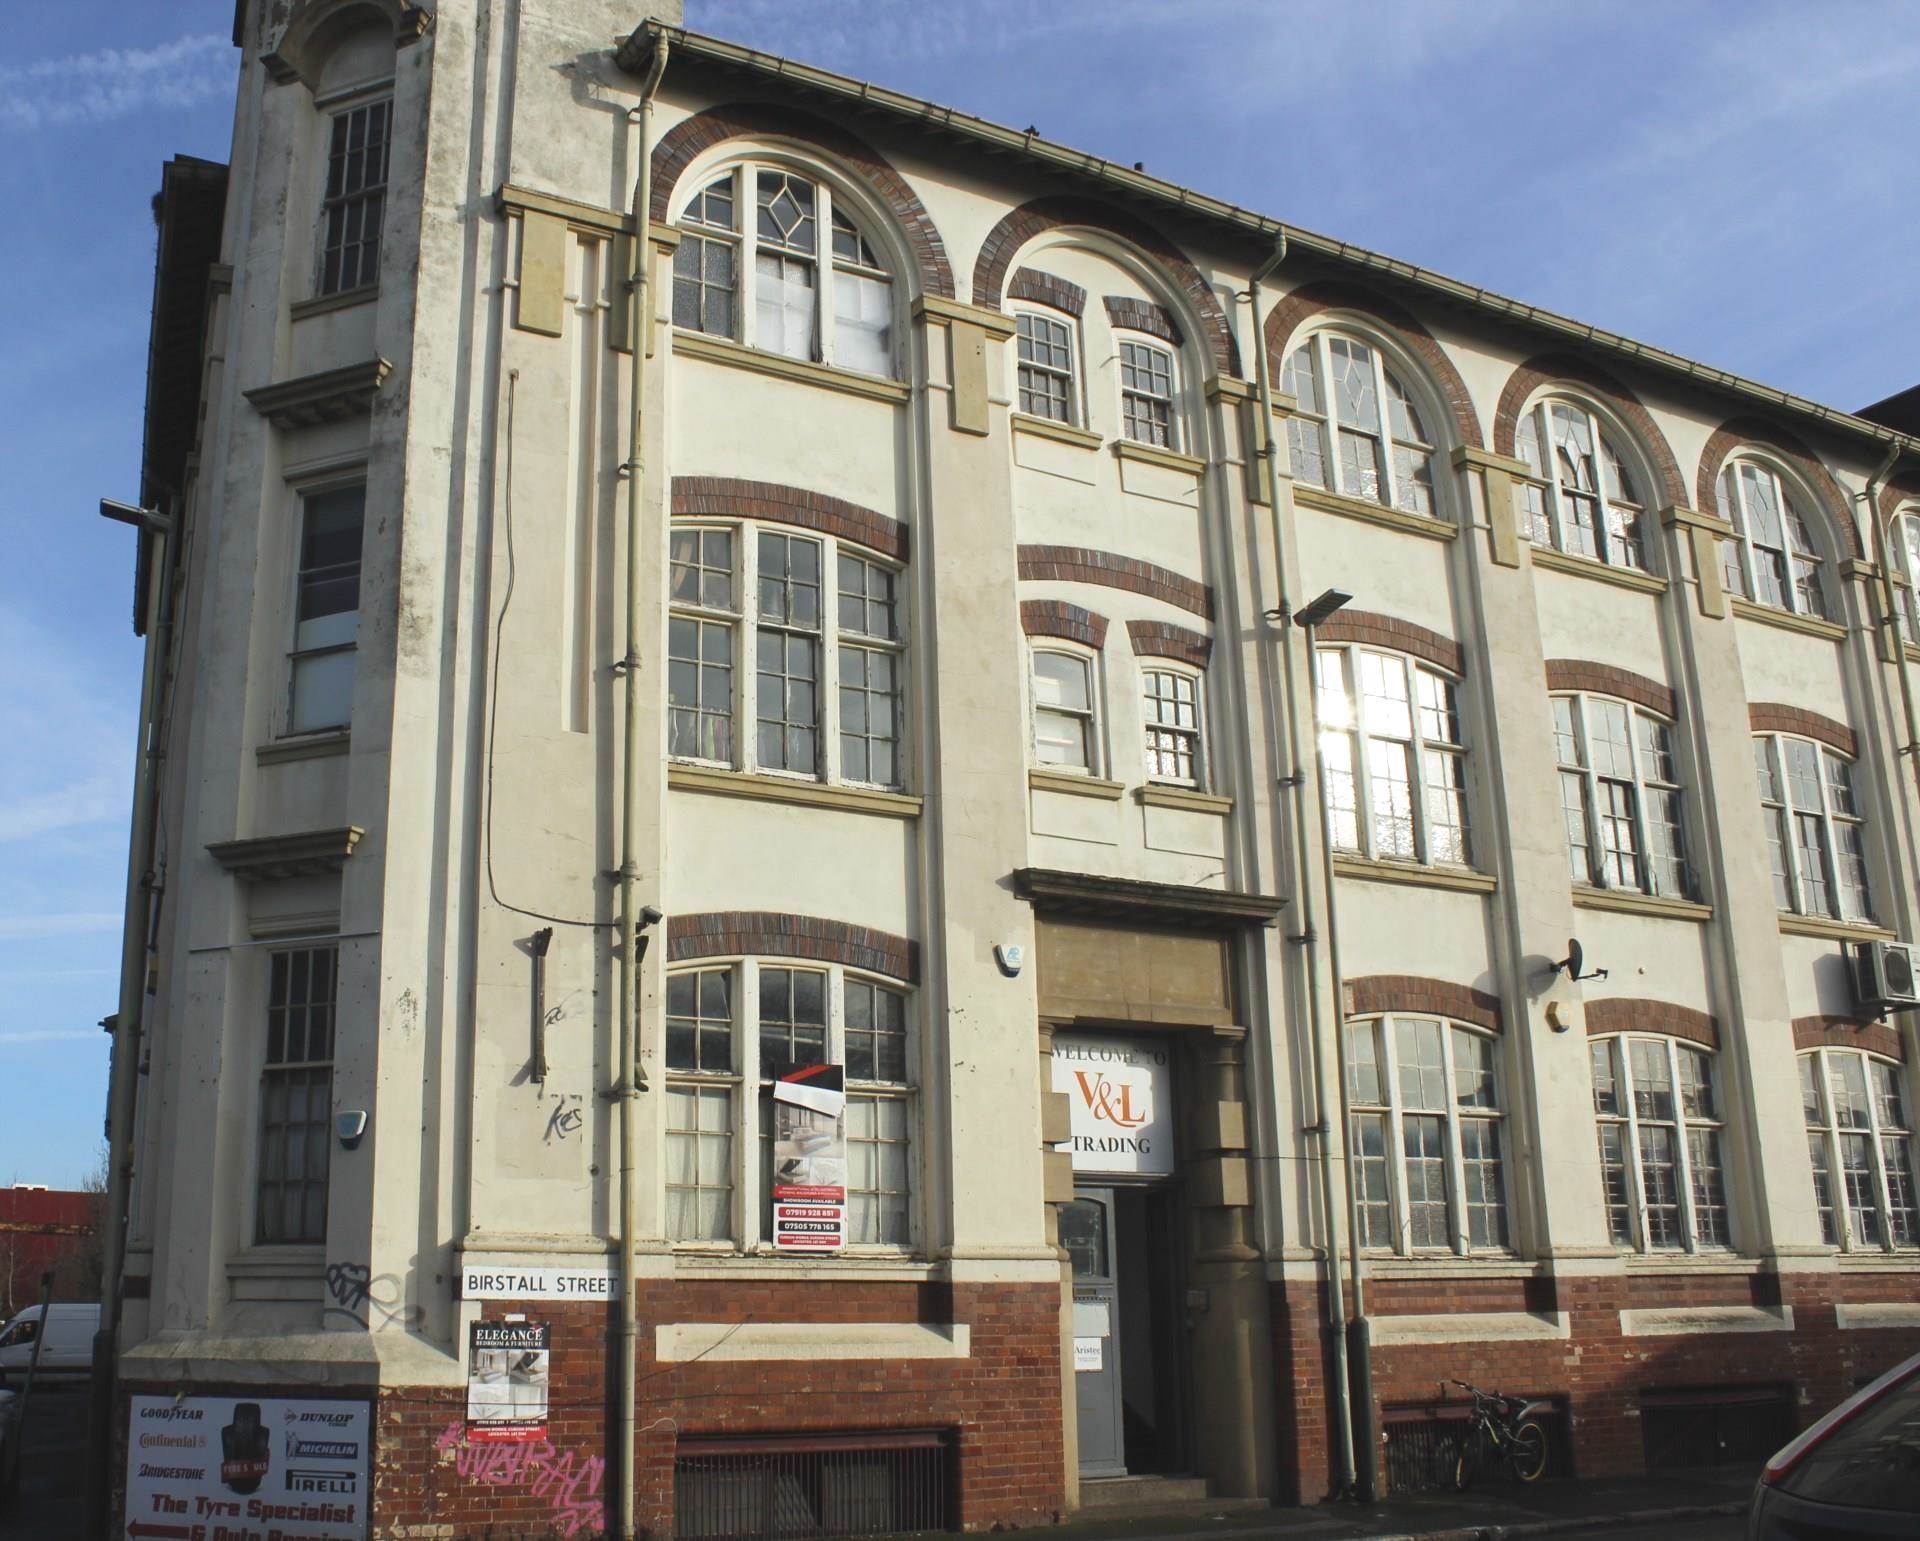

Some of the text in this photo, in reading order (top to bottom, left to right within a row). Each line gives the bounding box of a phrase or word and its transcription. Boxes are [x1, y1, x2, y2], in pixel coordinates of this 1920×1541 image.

[1051, 1043, 1166, 1066] WELCOME TO
[1073, 1071, 1146, 1128] V&L
[1072, 1135, 1151, 1154] TRADING
[468, 1274, 618, 1293] BIRSTALL STREET
[476, 1328, 543, 1341] ELEGANCE
[140, 1406, 204, 1421] GOODYEAR
[300, 1412, 355, 1422] DUNLOP
[139, 1433, 197, 1449] Continental
[299, 1444, 356, 1455] MICHELIN
[137, 1464, 206, 1480] BRIDGESTONE
[285, 1469, 357, 1494] PIRELLI
[152, 1494, 355, 1524] The Tyre Specialist
